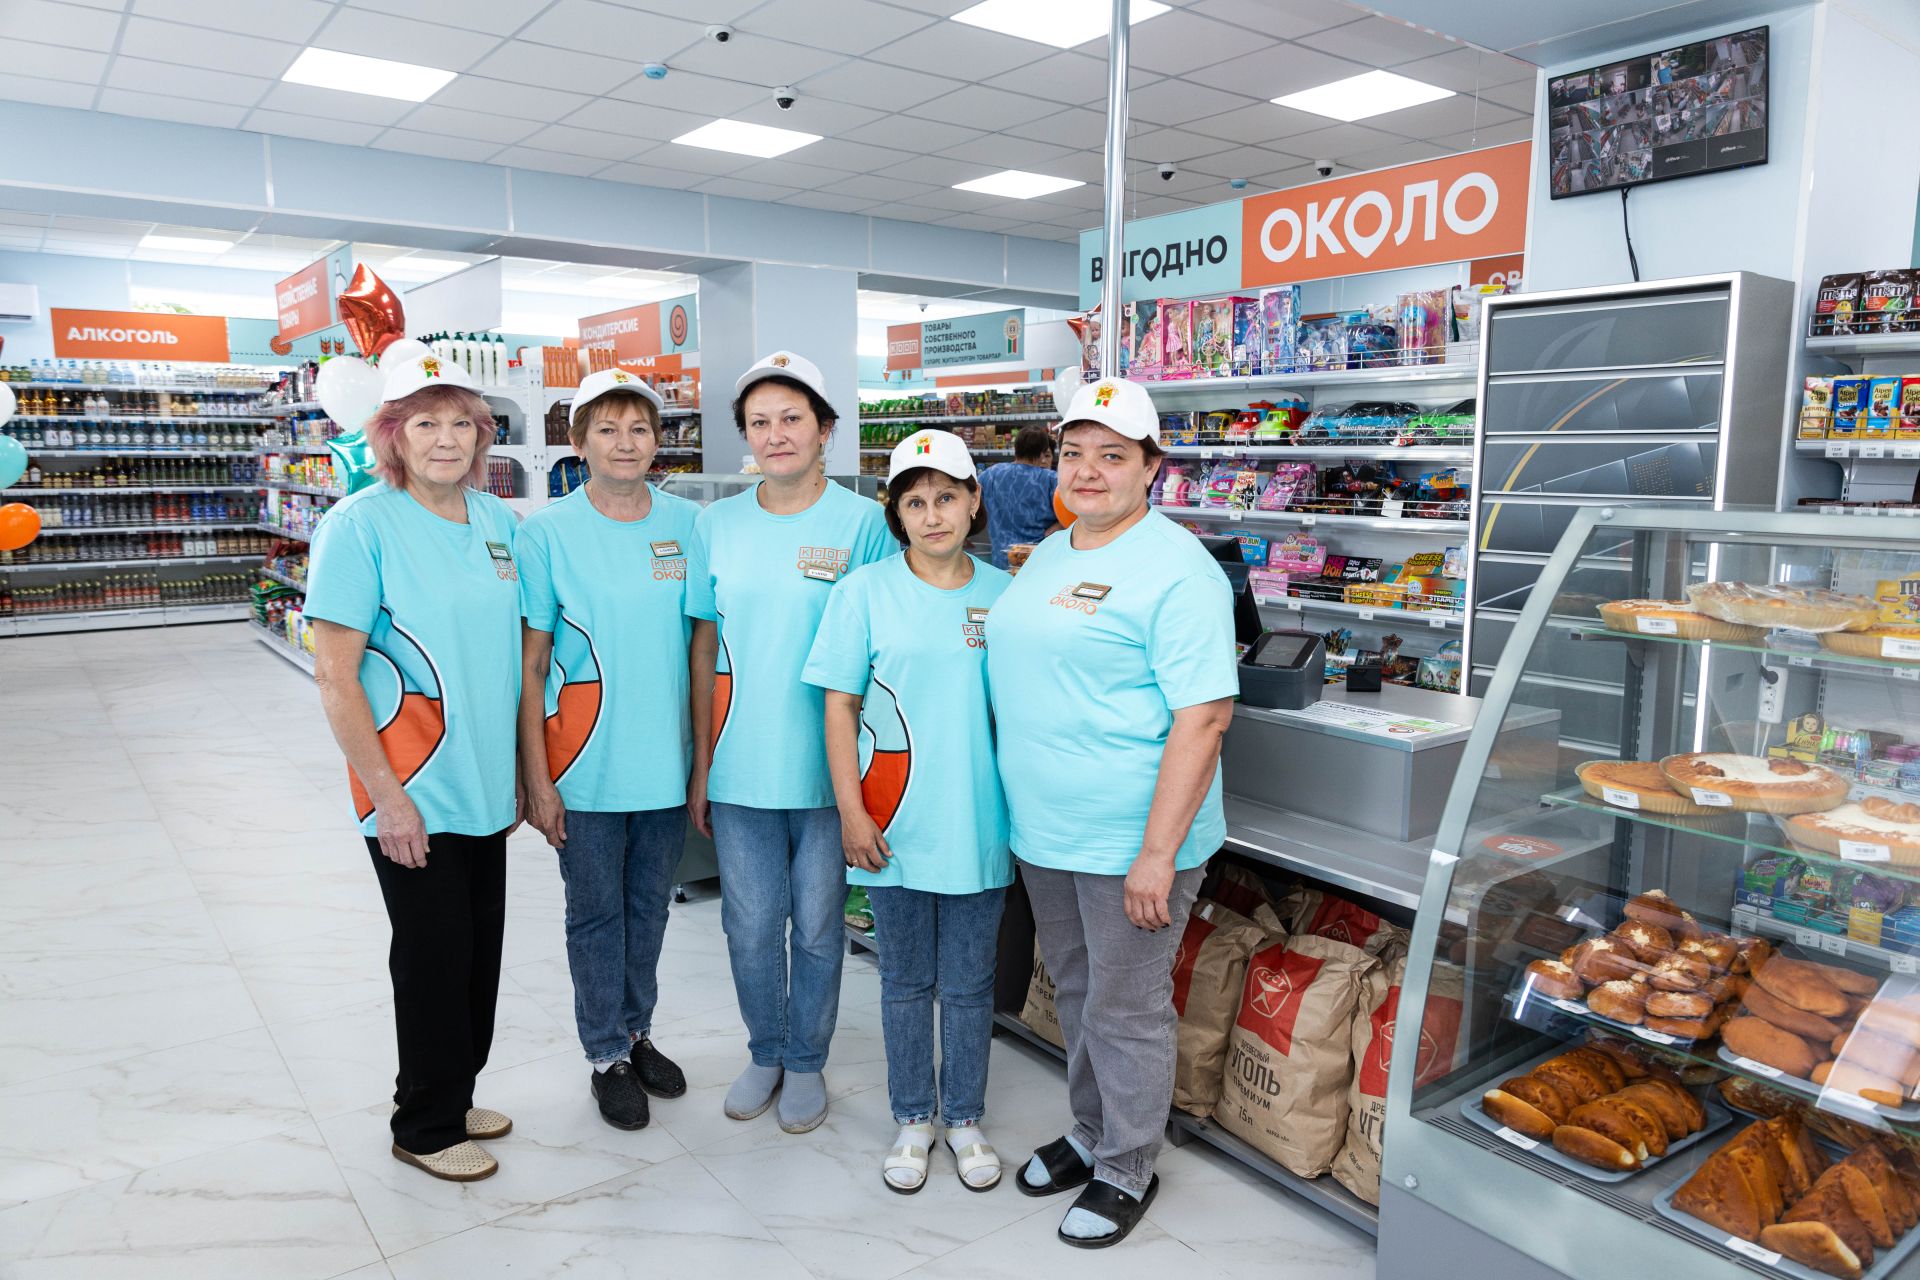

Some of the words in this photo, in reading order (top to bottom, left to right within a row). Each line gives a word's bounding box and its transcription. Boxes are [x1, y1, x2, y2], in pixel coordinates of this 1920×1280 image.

[1260, 171, 1499, 263] ОКОЛО
[1091, 234, 1228, 283] ВГОДНО
[67, 326, 179, 345] АЛКОГОЛЬ
[924, 322, 952, 333] ТОВАРЫ
[924, 330, 976, 344] СОБСТВЕННОГО
[924, 342, 977, 355] ПРОИЗВОДСТВА
[1241, 1039, 1270, 1064] ДРЕВЕСНЫЙ
[1231, 1045, 1281, 1097] УГОЛЬ
[1233, 1075, 1271, 1111] ПРЕМИУМ
[1359, 1107, 1385, 1148] УГ
